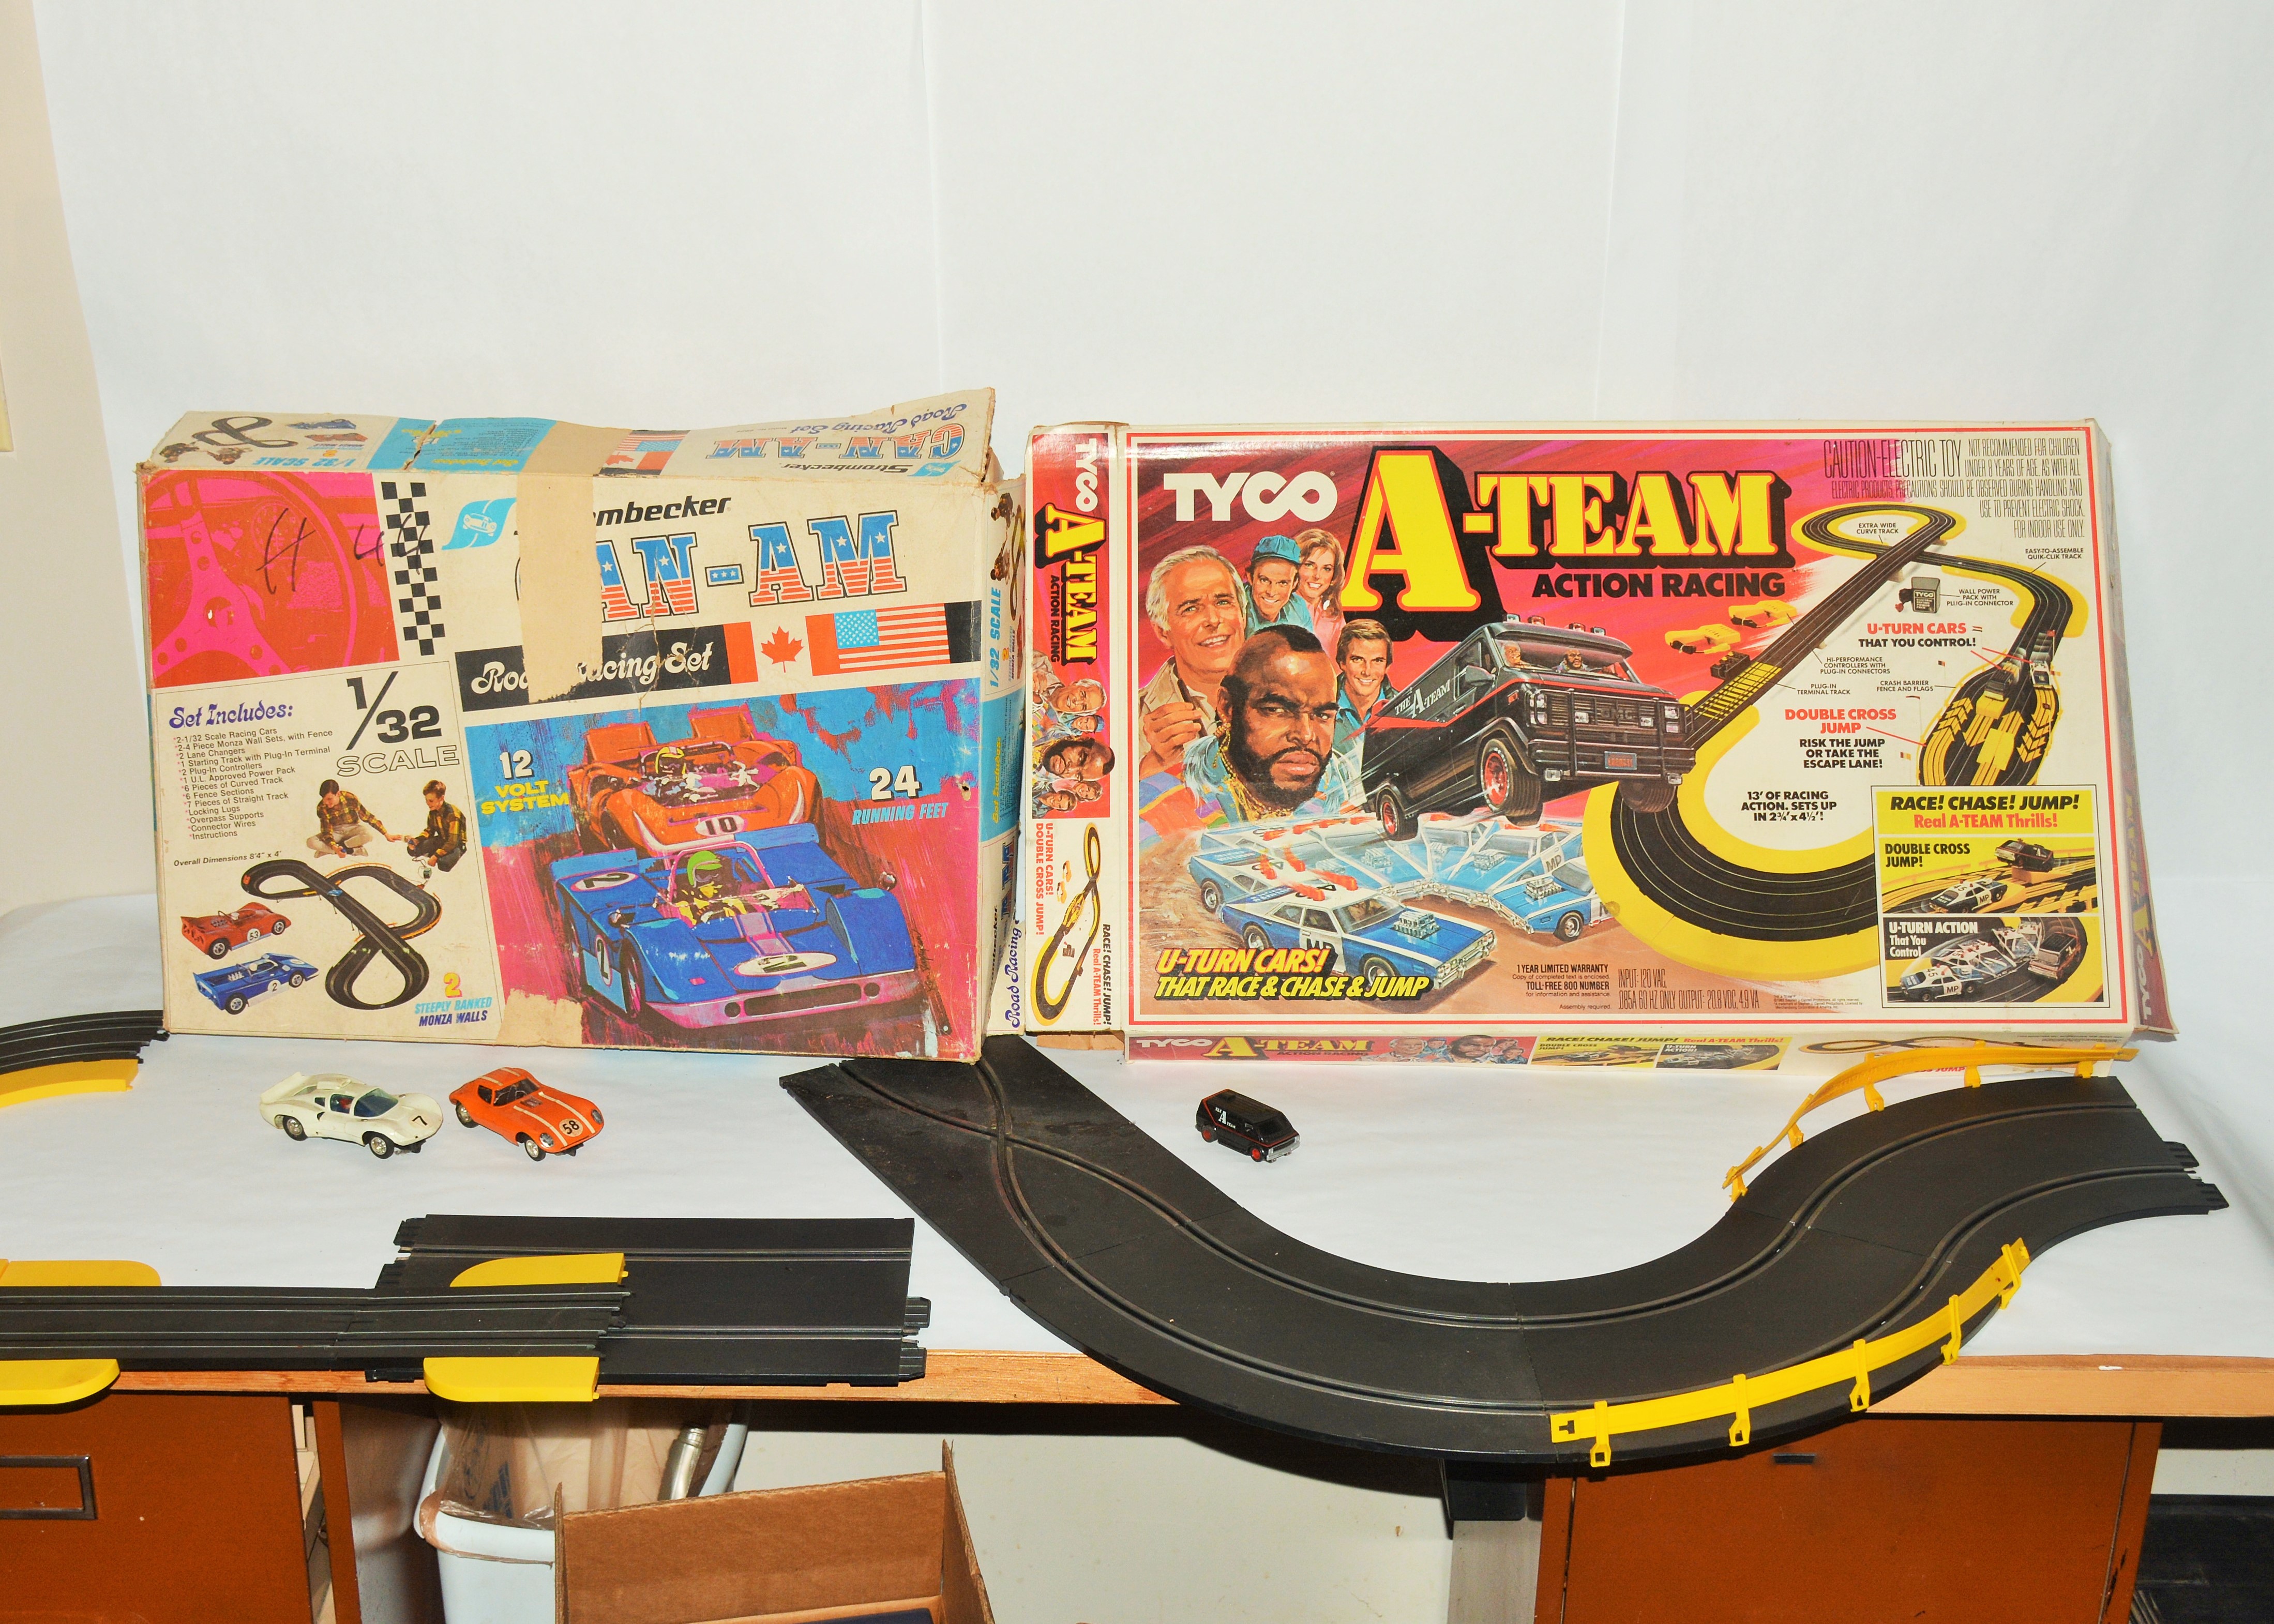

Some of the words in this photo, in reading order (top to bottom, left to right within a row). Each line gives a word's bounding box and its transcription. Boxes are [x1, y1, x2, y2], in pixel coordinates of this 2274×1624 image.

[911, 403, 967, 429] Road
[791, 424, 829, 434] Set
[833, 418, 908, 434] Racing
[705, 423, 965, 459] CAN-AM
[1968, 439, 1980, 456] NOT
[1982, 438, 2031, 456] RECOMMENDED
[2035, 438, 2046, 456] FOR
[2049, 438, 2080, 456] CHILDREN
[253, 457, 309, 466] SCALE
[312, 458, 356, 467] 1/32
[1824, 439, 1936, 478] CAUTION-ELECTRIC
[1939, 439, 1961, 477] TOY
[781, 463, 913, 473] Strombecker
[1075, 438, 1098, 512] TYCO
[593, 495, 731, 526] mbecker
[1164, 471, 1338, 522] TYCO
[1342, 447, 1780, 613] A-TEAM
[2014, 520, 2025, 538] FOR
[2028, 520, 2052, 538] INDOOR
[2054, 520, 2066, 537] USE
[2068, 520, 2084, 537] ONLY.
[596, 510, 908, 623] AN-AM
[1044, 504, 1105, 666] A-TEAM
[1532, 573, 1655, 598] ACTION
[1662, 572, 1786, 598] RACING
[1050, 575, 1060, 617] ACTION
[991, 587, 1002, 644] SCALE
[1867, 623, 1924, 634] U-TURN
[1927, 623, 1966, 634] CARS
[1050, 619, 1060, 663] RACING
[1859, 639, 1888, 647] THAT
[1891, 639, 1915, 647] YOU
[1918, 638, 1976, 647] CONTROL!
[664, 641, 714, 674] Set
[989, 648, 1000, 687] 1/32
[169, 706, 201, 728] Set
[206, 700, 293, 725] Includes:
[345, 671, 442, 750] 1/32
[1785, 709, 1845, 720] DOUBLE
[1848, 708, 1896, 720] CROSS
[176, 735, 202, 743] 2-1/32
[230, 730, 256, 738] Racing
[308, 730, 333, 738] Fence
[1820, 723, 1861, 734] JUMP
[1799, 739, 1827, 747] RISK
[1829, 739, 1851, 747] THE
[1854, 739, 1885, 747] JUMP
[337, 745, 460, 777] SCALE
[1806, 749, 1824, 758] OR
[1825, 749, 1854, 757] TAKE
[1857, 749, 1879, 757] THE
[499, 750, 534, 781] 12
[1849, 759, 1883, 768] LANE!
[494, 780, 549, 799] VOLT
[869, 764, 922, 801] 24
[481, 792, 570, 816] SYSTEM
[1766, 791, 1781, 799] OF
[1784, 791, 1829, 800] RACING
[1890, 795, 1944, 810] RACE!
[1948, 795, 2015, 810] CHASE!
[2019, 794, 2080, 810] JUMP!
[189, 808, 219, 816] Locking
[852, 805, 915, 826] RUNNING
[918, 802, 950, 821] FEET
[1741, 802, 1788, 811] ACTION.
[1791, 802, 1818, 811] SETS
[190, 816, 226, 824] Overpass
[229, 812, 264, 821] Supports
[704, 817, 736, 834] 10
[1914, 814, 1946, 828] Real
[1949, 814, 2004, 828] A-TEAM
[2007, 813, 2057, 827] Thrills!
[191, 824, 231, 832] Connector
[192, 830, 238, 840] Instructions
[1885, 843, 1931, 855] DOUBLE
[1934, 843, 1970, 855] CROSS
[174, 856, 200, 867] Overall
[203, 854, 247, 864] Dimensions
[1886, 856, 1923, 867] JUMP!
[1036, 902, 1044, 935] JUMP!
[1889, 923, 1933, 933] U-TURN
[1935, 922, 1978, 933] ACTION
[1103, 924, 1111, 954] RACE!
[1890, 935, 1908, 946] That
[1910, 935, 1926, 946] You
[1004, 929, 1021, 983] Racing
[1156, 948, 1257, 974] U-TURN
[1254, 948, 1331, 974] CARS!
[1890, 947, 1922, 958] Control
[1103, 955, 1111, 989] CHASE!
[1540, 964, 1569, 973] LIMITED
[1571, 964, 1608, 973] WARRANTY
[444, 972, 462, 998] 2
[1156, 977, 1211, 997] THAT
[1208, 977, 1262, 997] RACE
[1262, 977, 1276, 997] &
[1281, 977, 1345, 997] CHASE
[1347, 977, 1363, 997] &
[1364, 977, 1429, 997] JUMP
[1526, 982, 1562, 990] TOLL-FREE
[1564, 982, 1577, 990] 800
[2136, 945, 2152, 1020] TYCO
[415, 1001, 450, 1014] STEEPLY
[455, 997, 492, 1011] BANKED
[1005, 986, 1020, 1028] Road
[1093, 996, 1102, 1025] Thrills!
[1103, 990, 1112, 1025] JUMP!
[419, 1013, 453, 1027] MONZA
[456, 1010, 488, 1024] WALLS
[1136, 1039, 1212, 1048] TYCO
[1203, 1037, 1369, 1057] A-TEAM
[413, 1116, 429, 1126] 7
[1218, 1111, 1227, 1125] A
[562, 1120, 580, 1135] 58
